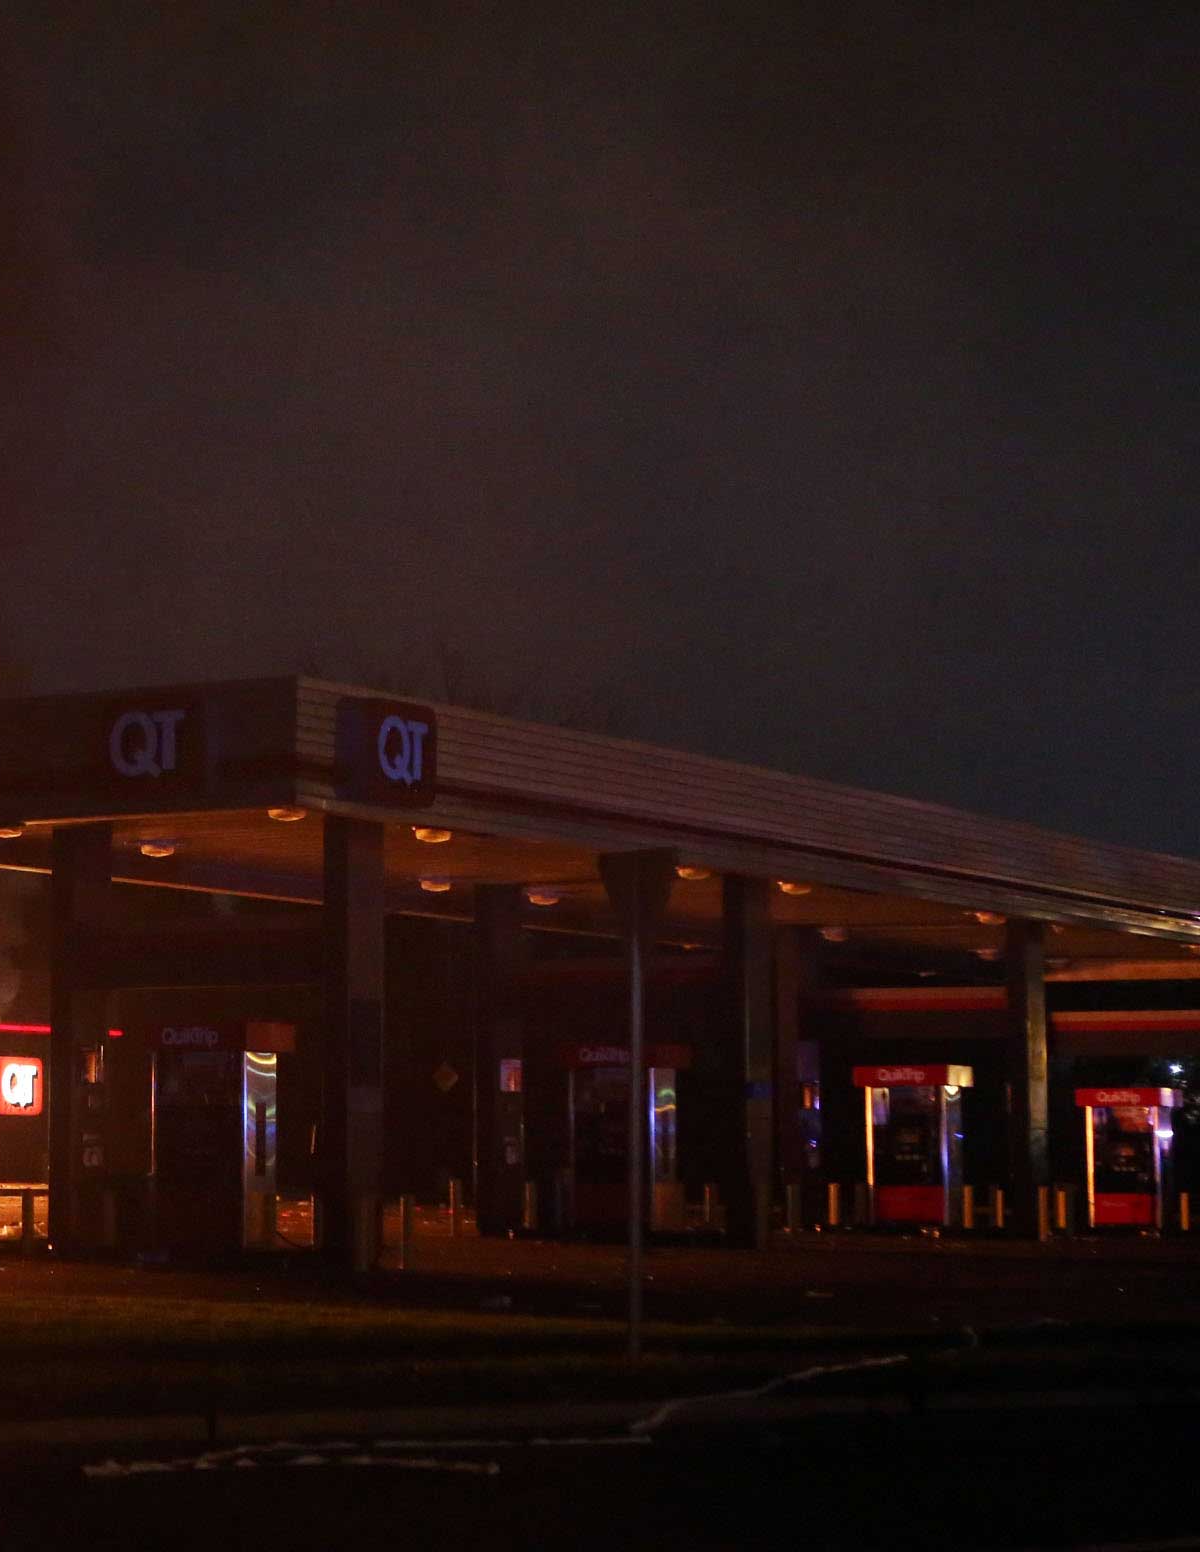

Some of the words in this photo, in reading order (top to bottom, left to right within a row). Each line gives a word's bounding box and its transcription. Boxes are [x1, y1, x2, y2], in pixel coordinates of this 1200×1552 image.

[110, 709, 187, 778] QT
[377, 714, 429, 787] QT
[1, 1062, 38, 1108] QT
